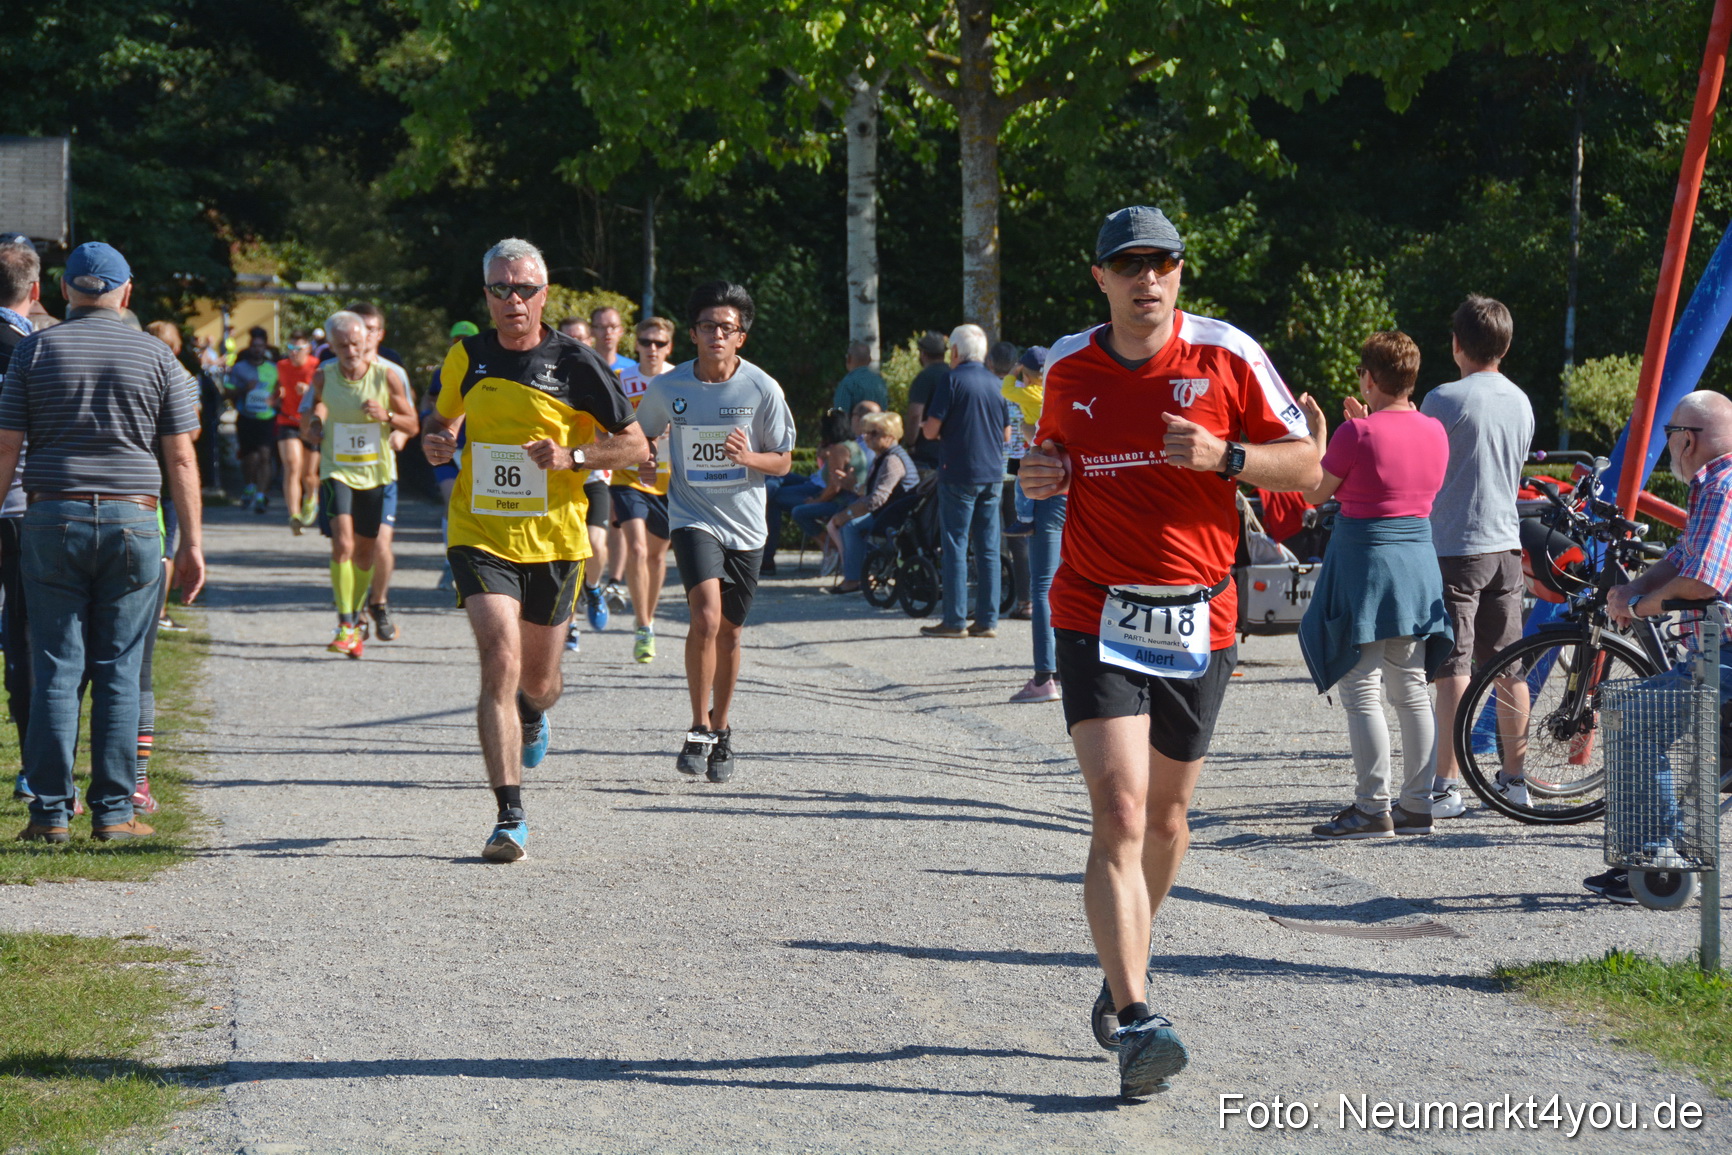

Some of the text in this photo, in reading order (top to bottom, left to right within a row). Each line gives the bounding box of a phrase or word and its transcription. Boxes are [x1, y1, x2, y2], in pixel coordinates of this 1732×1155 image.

[719, 407, 754, 416] BOCK
[698, 431, 727, 439] BOCK
[349, 435, 366, 449] 16
[491, 450, 524, 460] BOCK
[692, 443, 734, 462] 205
[1148, 450, 1155, 459] &
[494, 464, 522, 487] 86
[704, 471, 728, 481] Jason
[705, 487, 739, 495] Stadtlauf
[496, 499, 520, 510] Peter
[1118, 601, 1196, 636] 2118
[1123, 632, 1180, 648] PARTL Neumarkt
[1134, 649, 1175, 667] Albert
